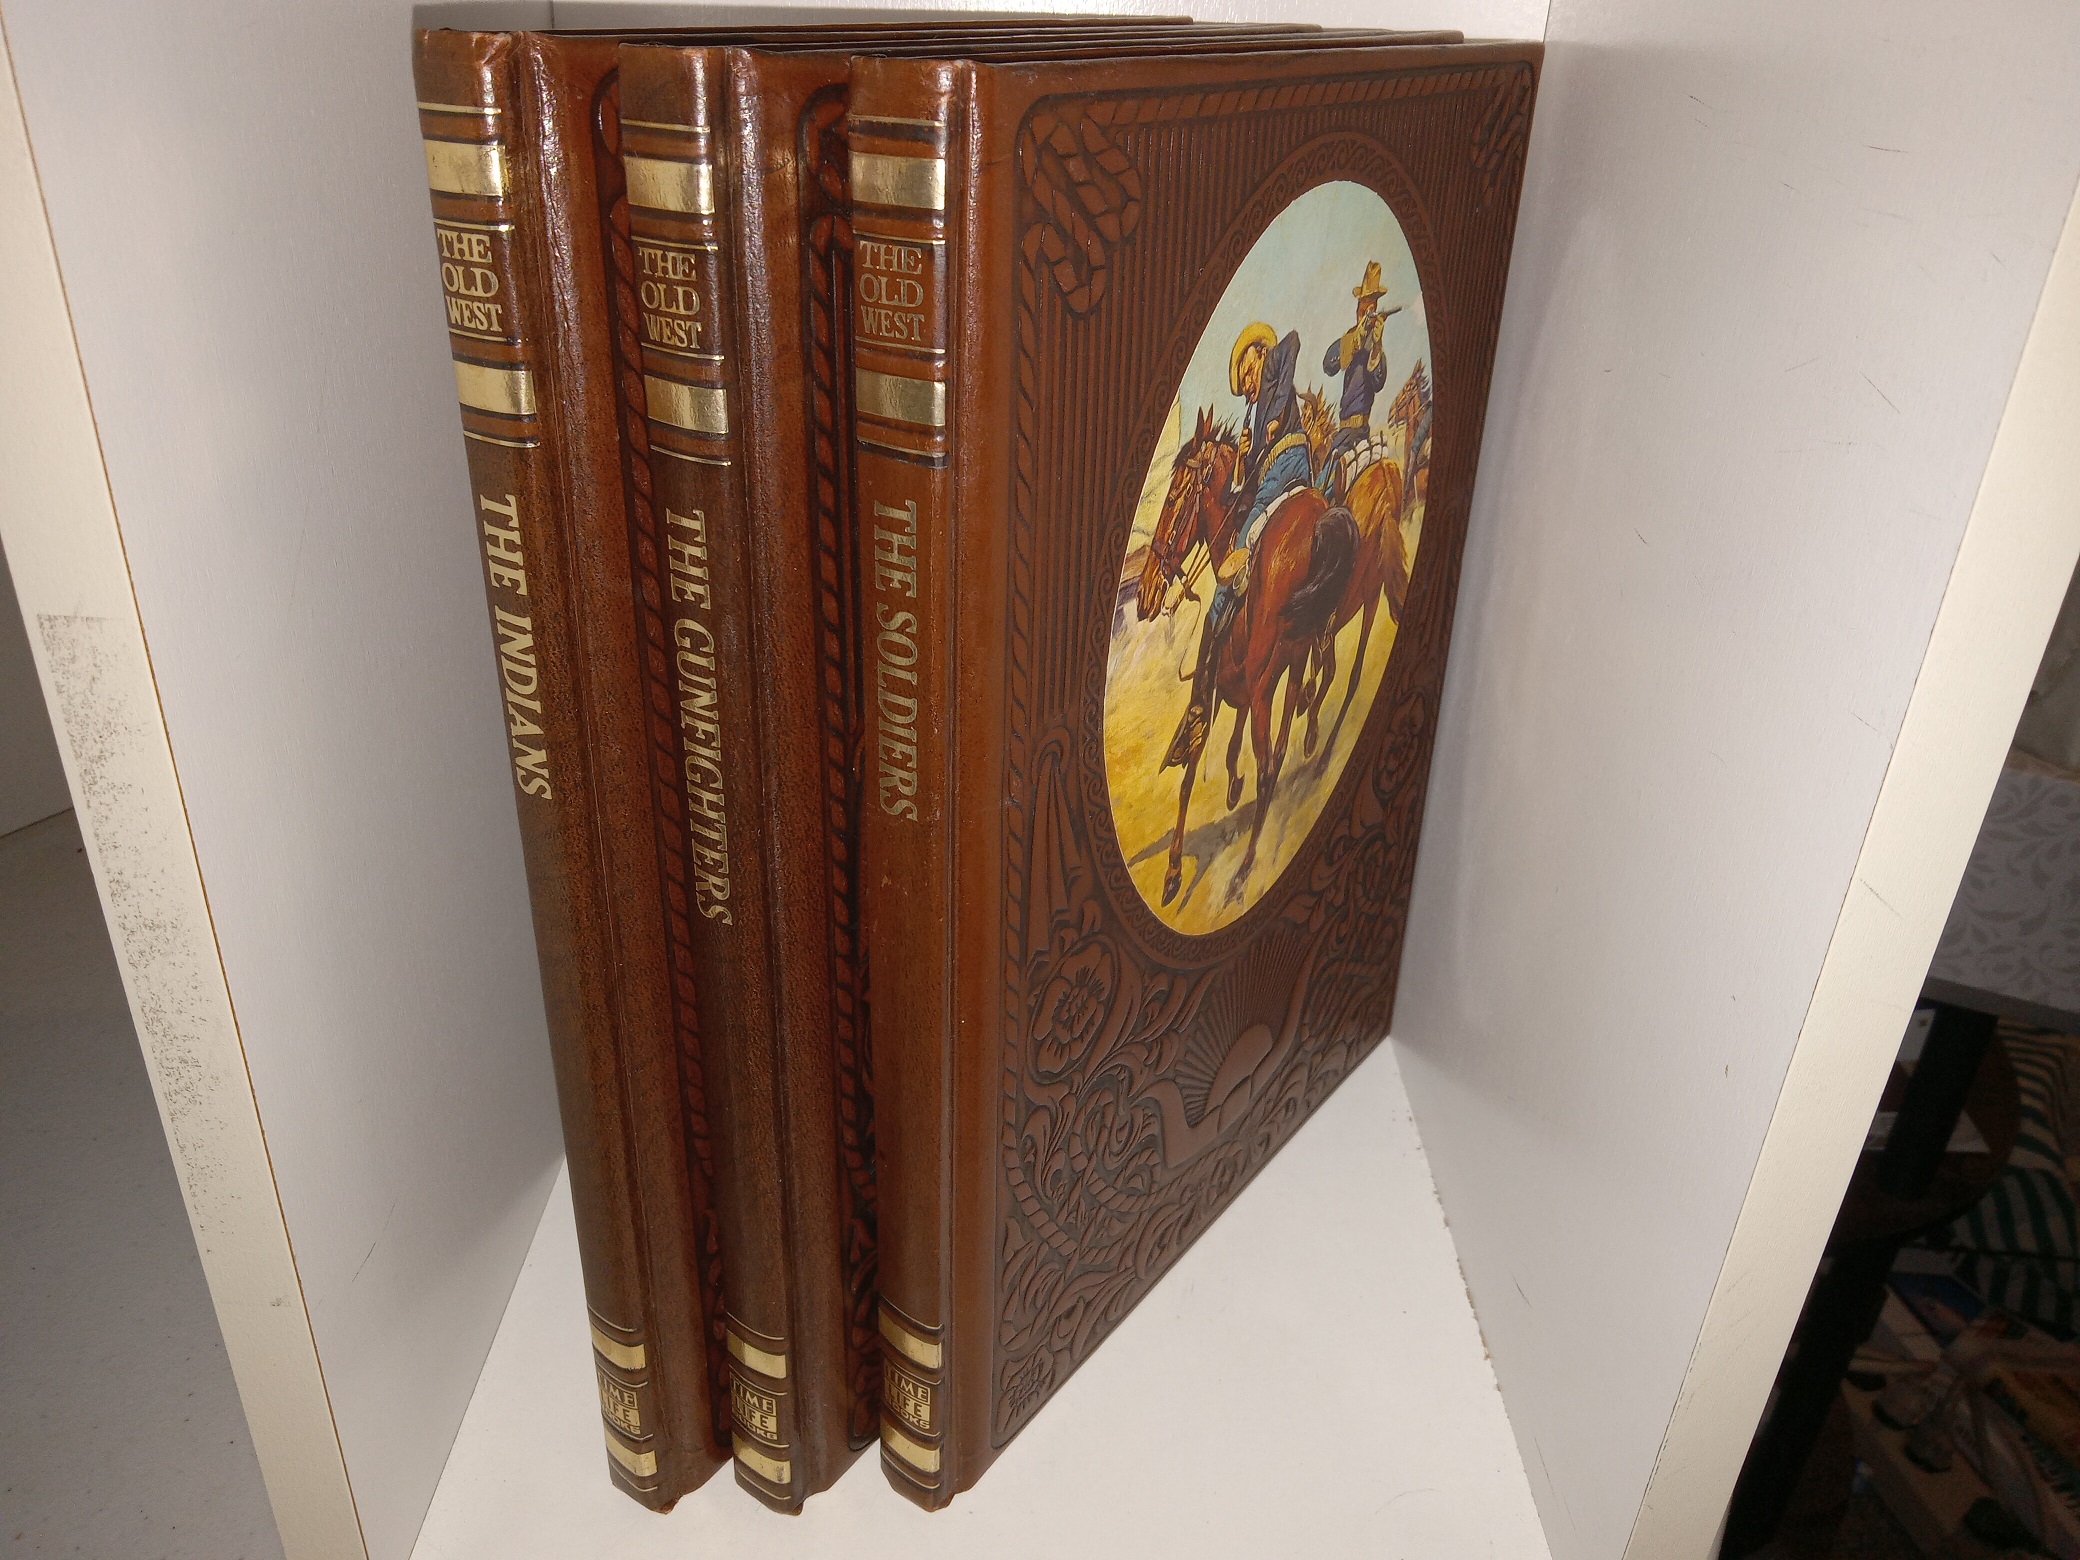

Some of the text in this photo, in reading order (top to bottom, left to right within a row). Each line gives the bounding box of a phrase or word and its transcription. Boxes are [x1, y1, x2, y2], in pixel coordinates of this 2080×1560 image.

[436, 229, 493, 263] THE
[638, 246, 697, 281] THE
[859, 241, 923, 275] THE
[441, 262, 499, 298] OLD
[859, 275, 924, 308] OLD
[641, 281, 700, 315] OLD
[445, 301, 504, 333] WEST
[643, 313, 702, 350] WEST
[861, 306, 925, 342] WEST
[480, 494, 552, 801] THE INDIANS
[874, 499, 919, 822] THE SOLDIERS
[665, 508, 733, 926] THE GUNFIGHTERS
[733, 1380, 773, 1414] TIME
[887, 1366, 927, 1401] TIME
[889, 1382, 923, 1418] LIFE
[736, 1396, 769, 1430] LIFE
